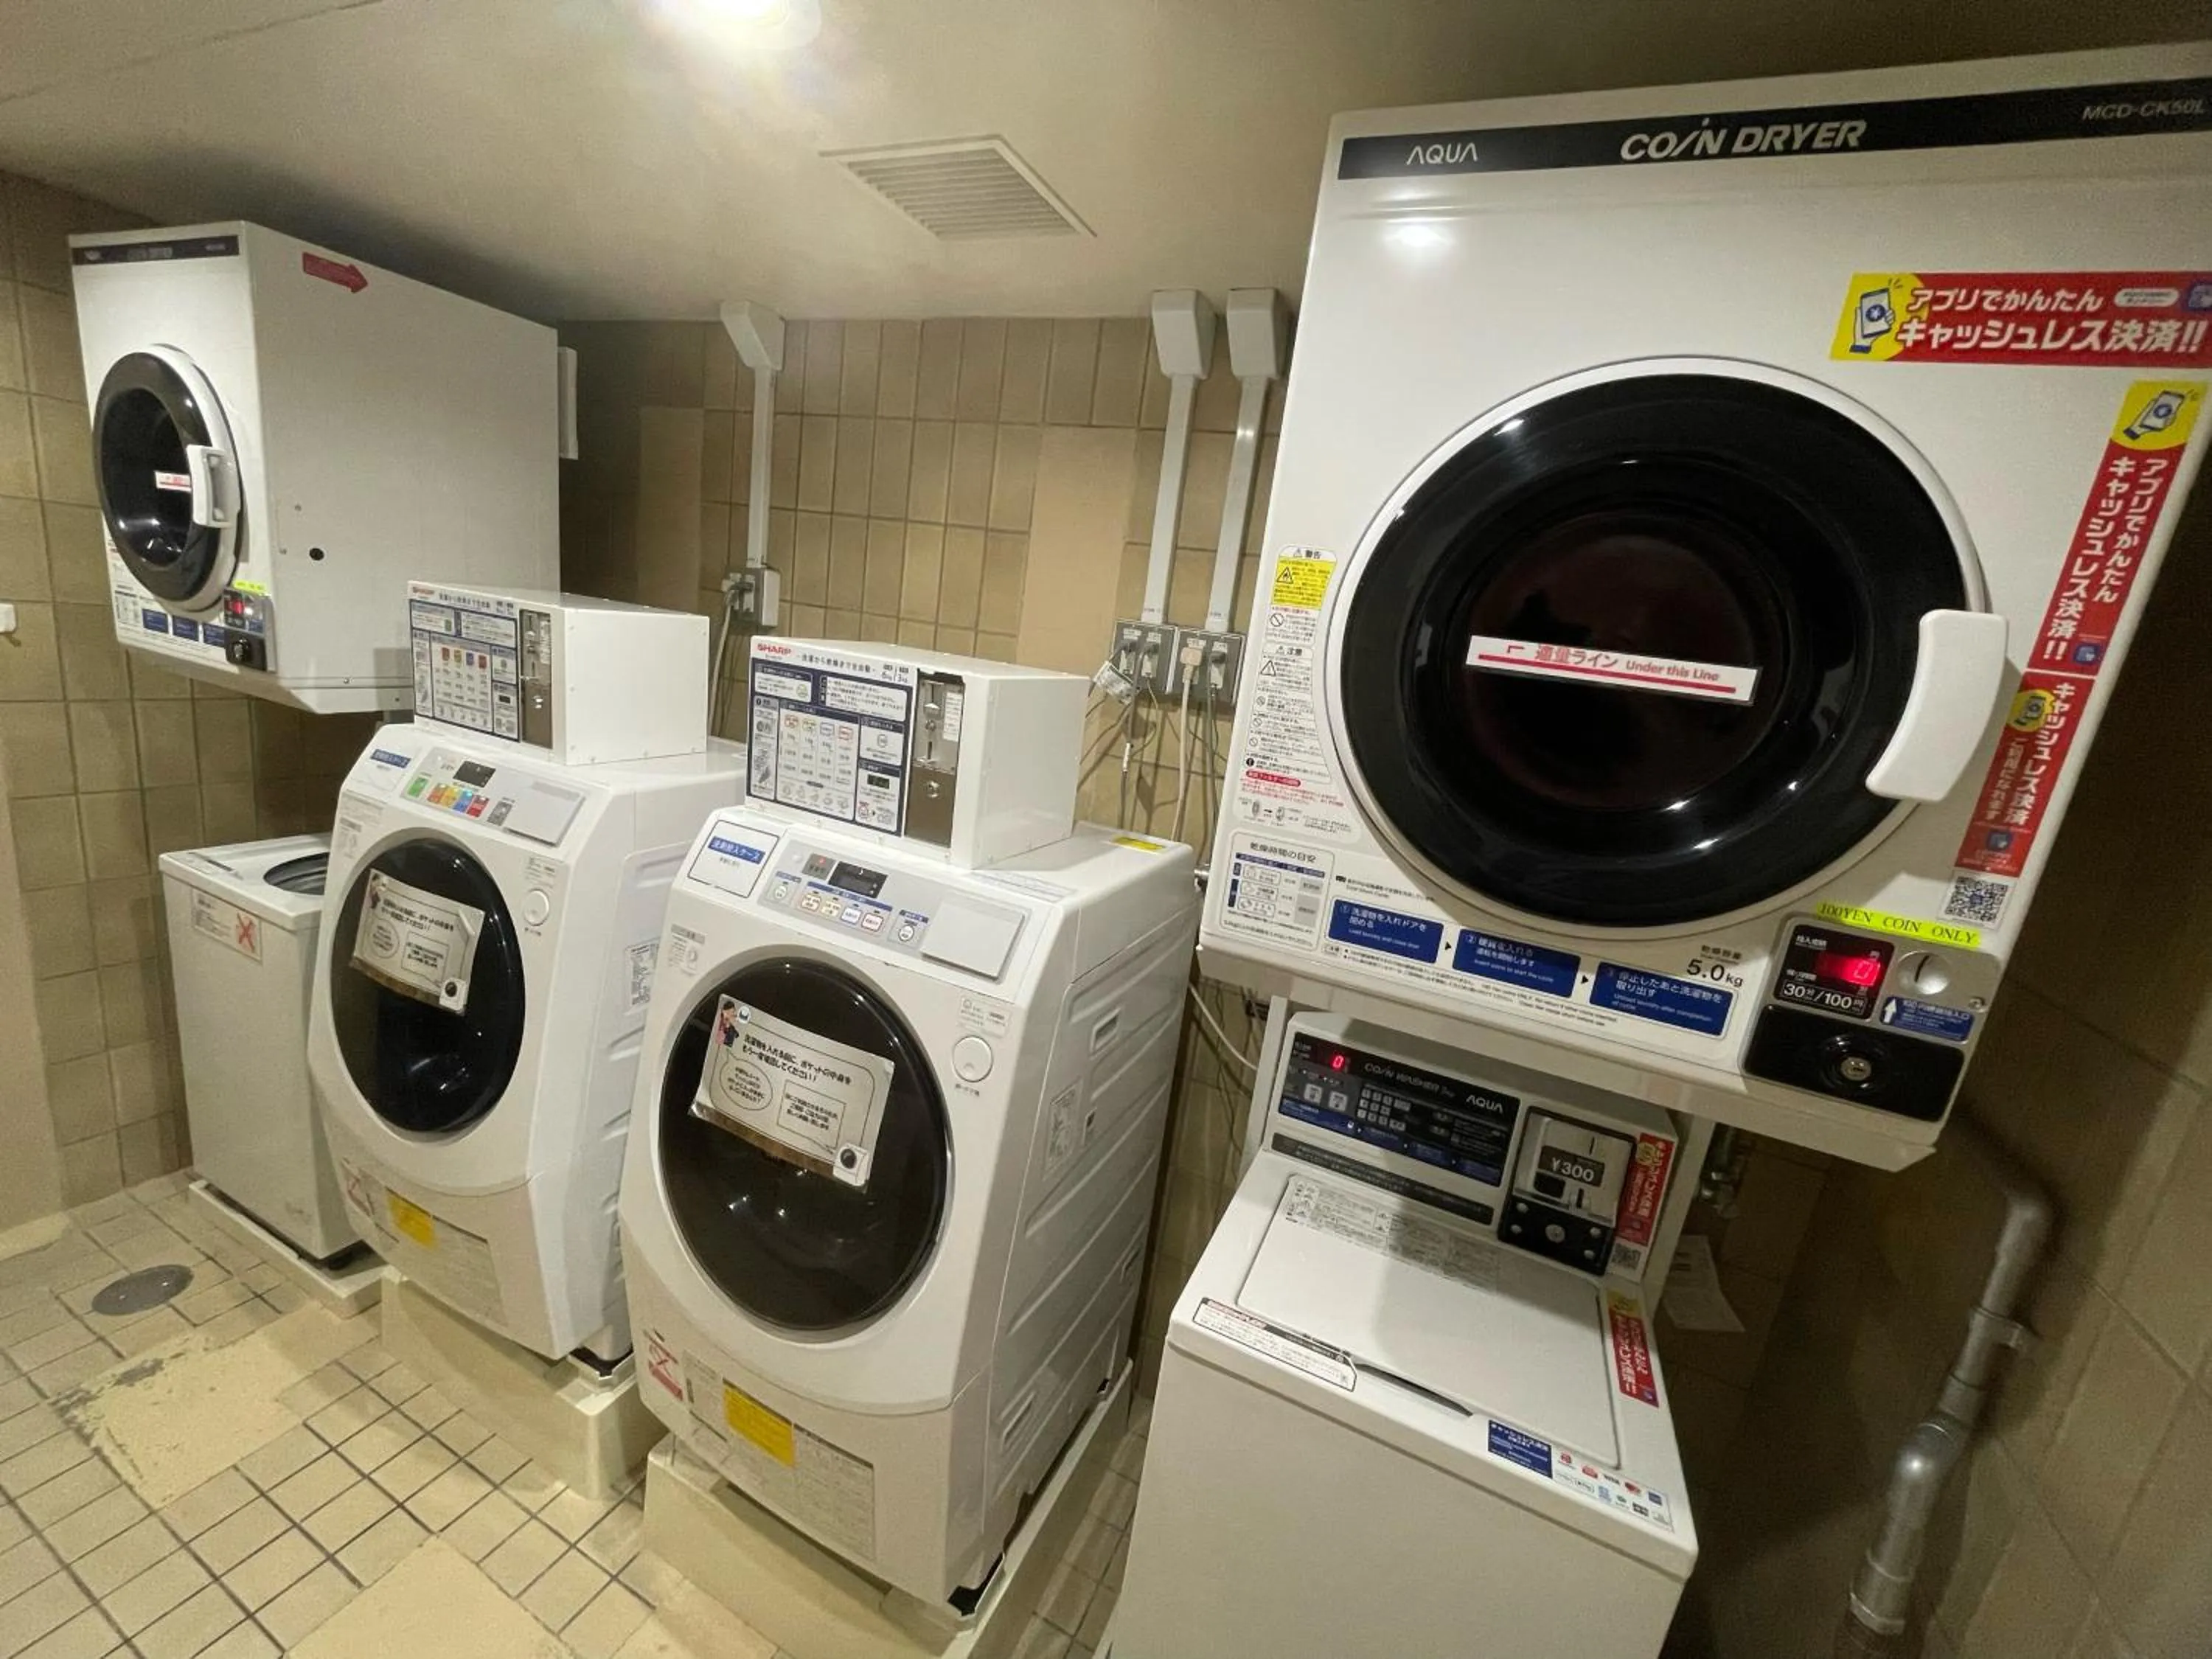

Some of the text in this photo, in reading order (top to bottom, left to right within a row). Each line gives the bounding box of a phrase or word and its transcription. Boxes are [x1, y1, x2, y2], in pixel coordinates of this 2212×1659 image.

[1621, 117, 1867, 161] COIN DRYER
[1405, 142, 1478, 166] AQUA
[1907, 286, 2105, 312] アプリでかんたん
[2092, 458, 2170, 604] アプリでかんたん
[1625, 659, 1665, 676] Under
[1666, 664, 1690, 679] this
[1693, 667, 1719, 682] Line
[1819, 902, 1978, 945] 100YEN COIN ONLY
[1615, 980, 1657, 997] 取り出す
[1465, 1093, 1504, 1114] AQUA
[1550, 1157, 1595, 1183] ¥300
